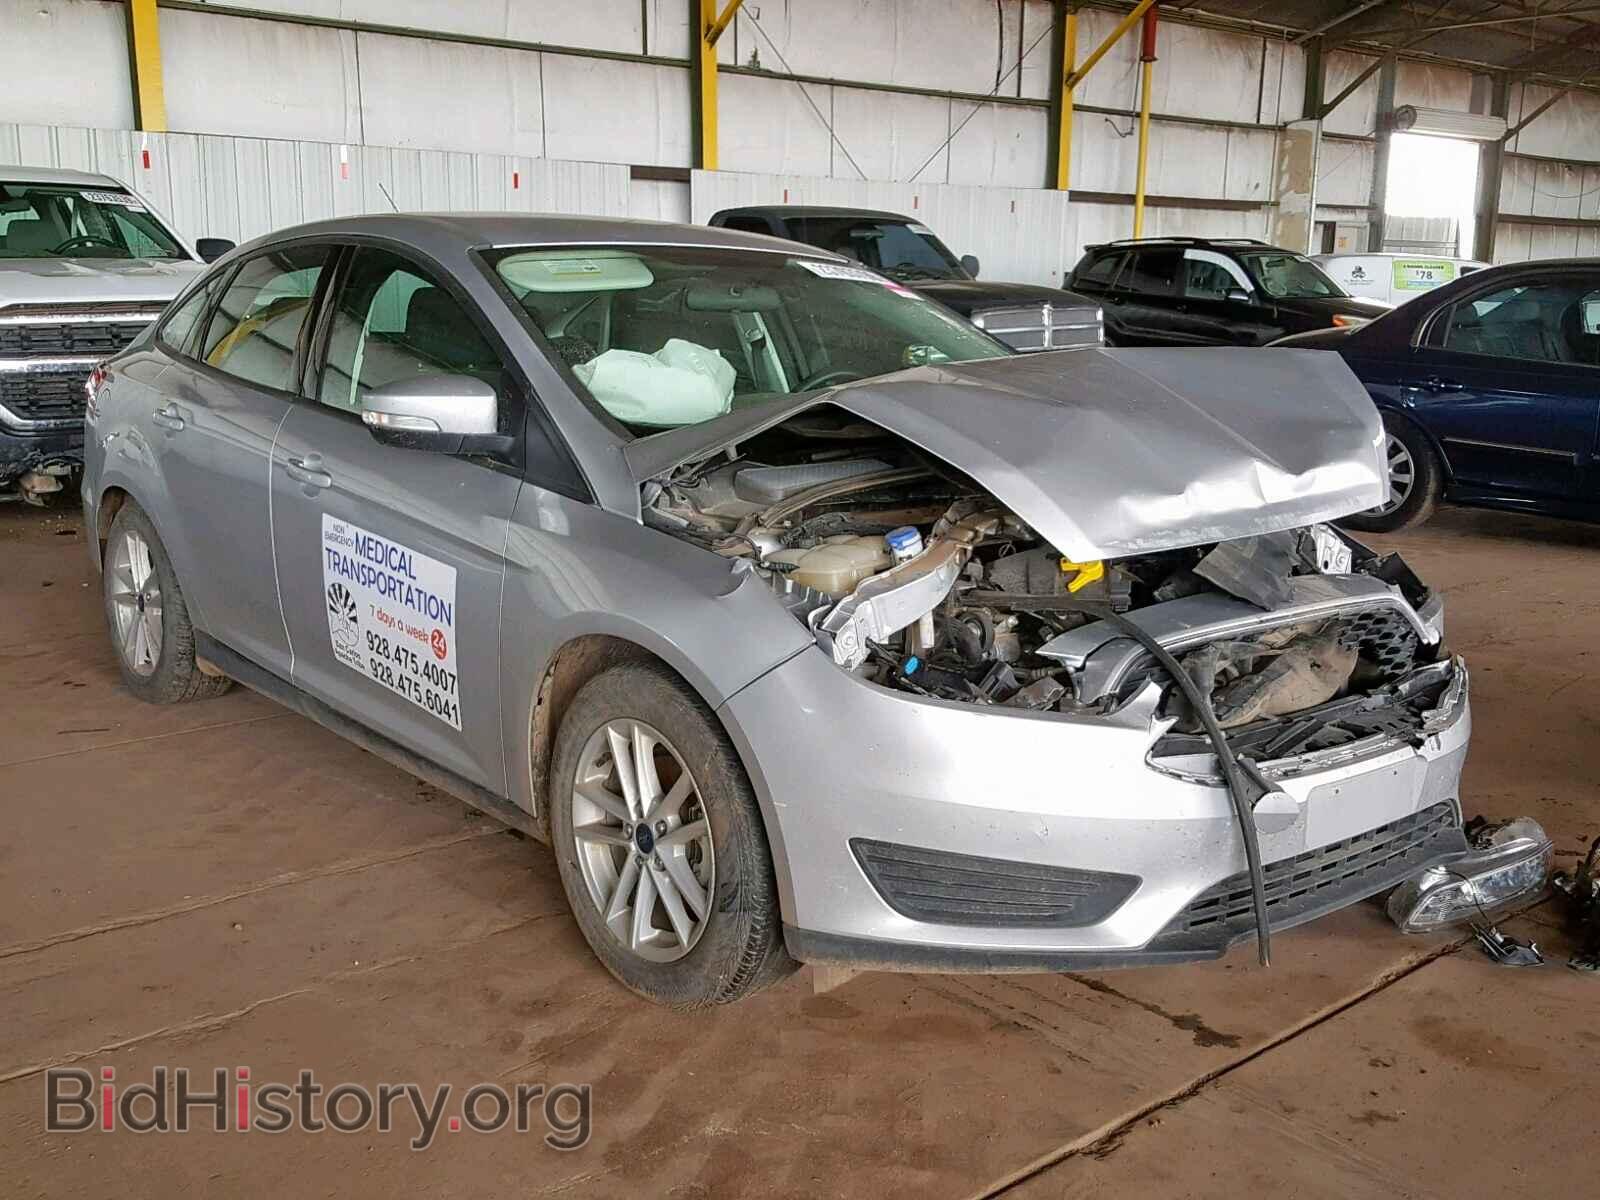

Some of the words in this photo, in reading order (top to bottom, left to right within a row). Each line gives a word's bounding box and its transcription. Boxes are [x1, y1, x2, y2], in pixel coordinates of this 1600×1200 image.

[1416, 270, 1433, 280] $78
[355, 531, 417, 580] MEDICAL
[325, 547, 452, 626] TRANSPORTATION
[376, 607, 396, 628] days
[397, 619, 404, 633] a
[405, 623, 429, 645] week
[366, 630, 457, 695] 928.475.4007
[369, 658, 459, 725] 928.475.6041
